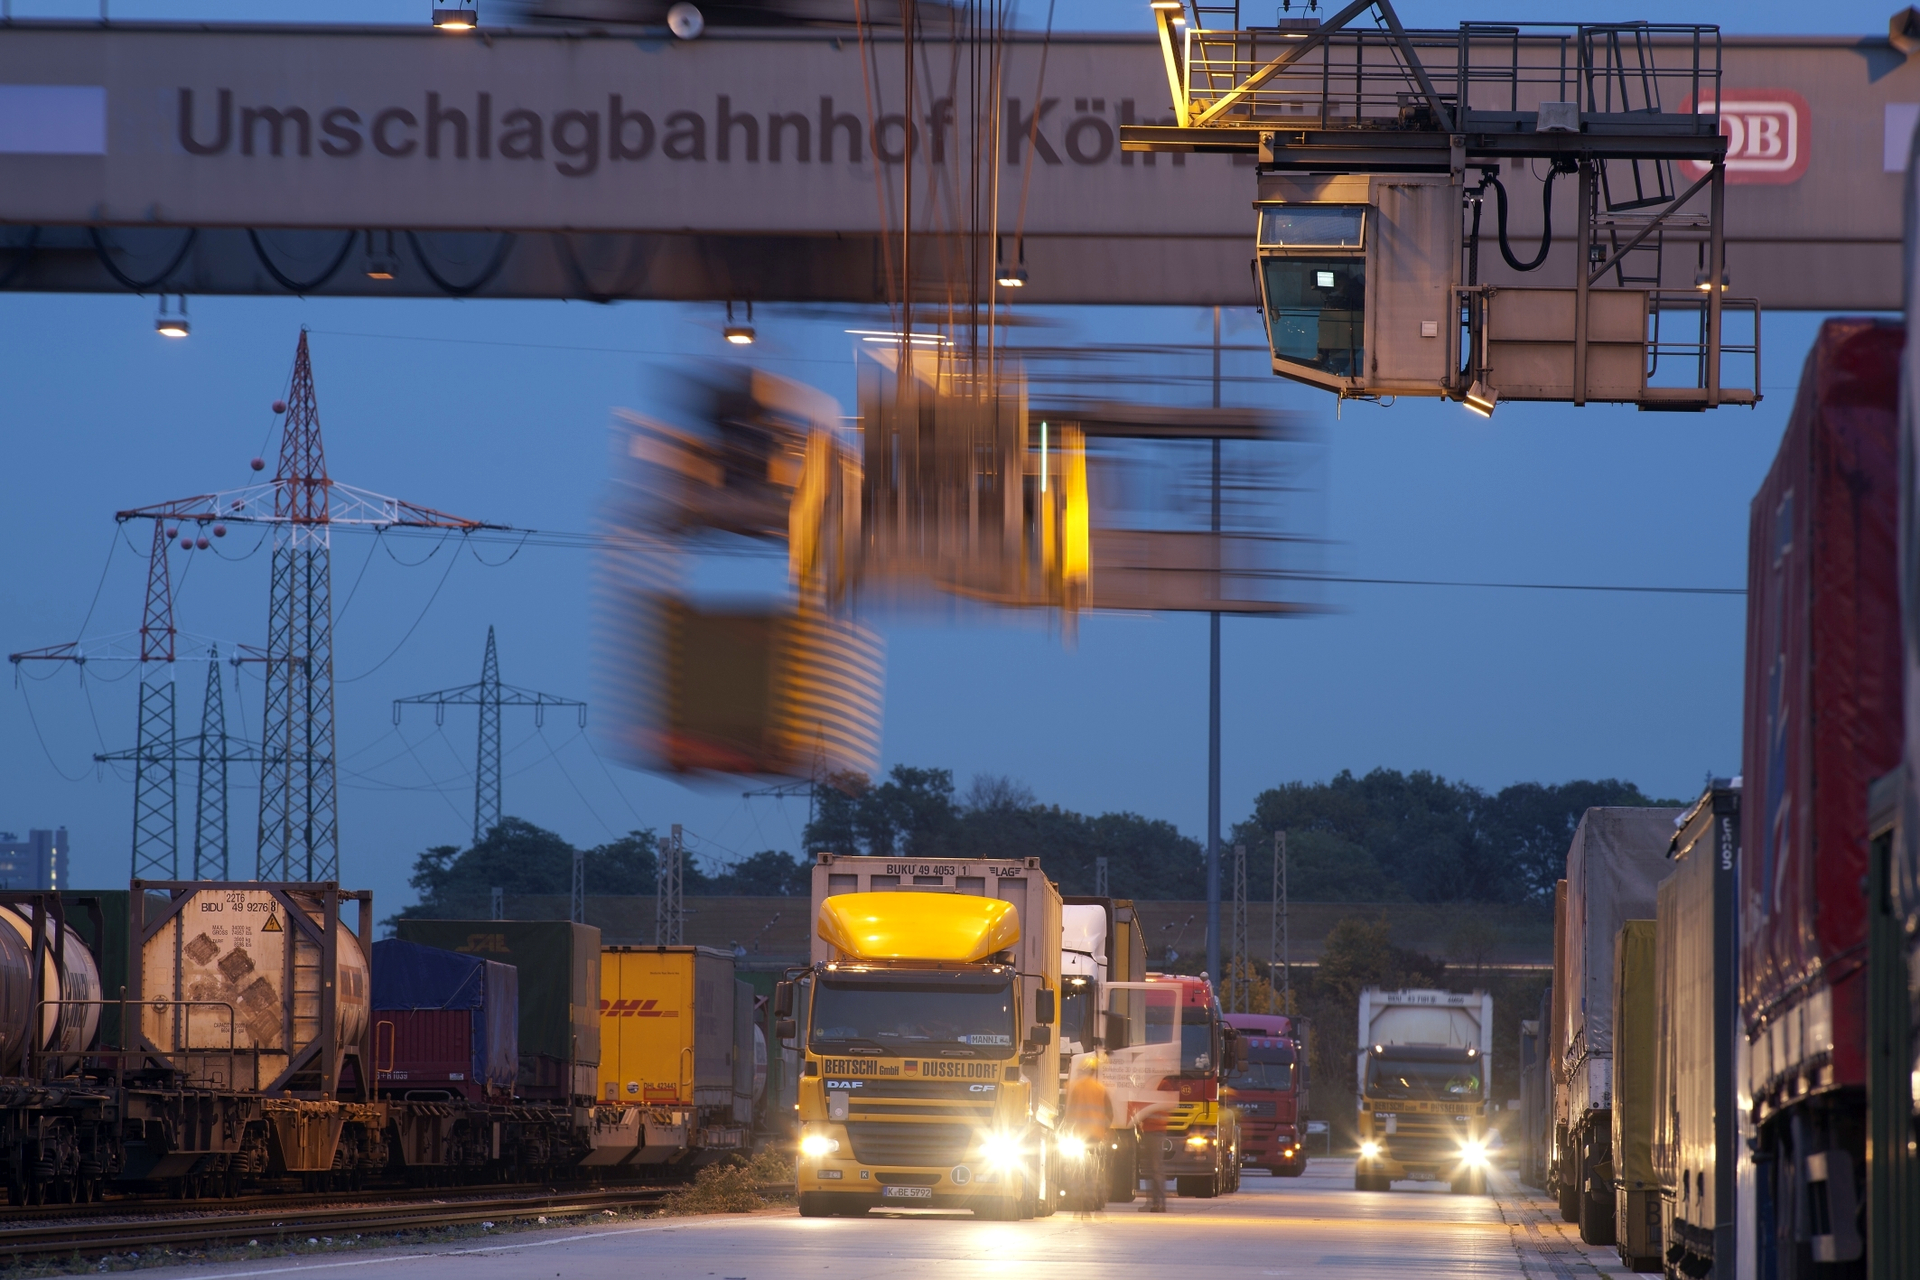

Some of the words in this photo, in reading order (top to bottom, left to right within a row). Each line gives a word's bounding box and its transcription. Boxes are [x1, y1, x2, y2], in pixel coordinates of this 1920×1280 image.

[178, 87, 953, 178] Umschlagbahnhof
[886, 864, 915, 875] BUKU
[919, 865, 930, 875] 49
[933, 865, 955, 876] 4053
[226, 893, 246, 903] 22T6
[201, 902, 224, 912] BIDU
[231, 902, 244, 912] 49
[246, 902, 269, 912] 9276
[971, 1035, 998, 1044] MANNI
[824, 1059, 878, 1076] BERTSCHI
[879, 1065, 900, 1076] GmbH
[827, 1081, 863, 1089] DAF
[969, 1084, 996, 1092] CF
[957, 1169, 966, 1183] L
[1646, 1201, 1661, 1226] B
